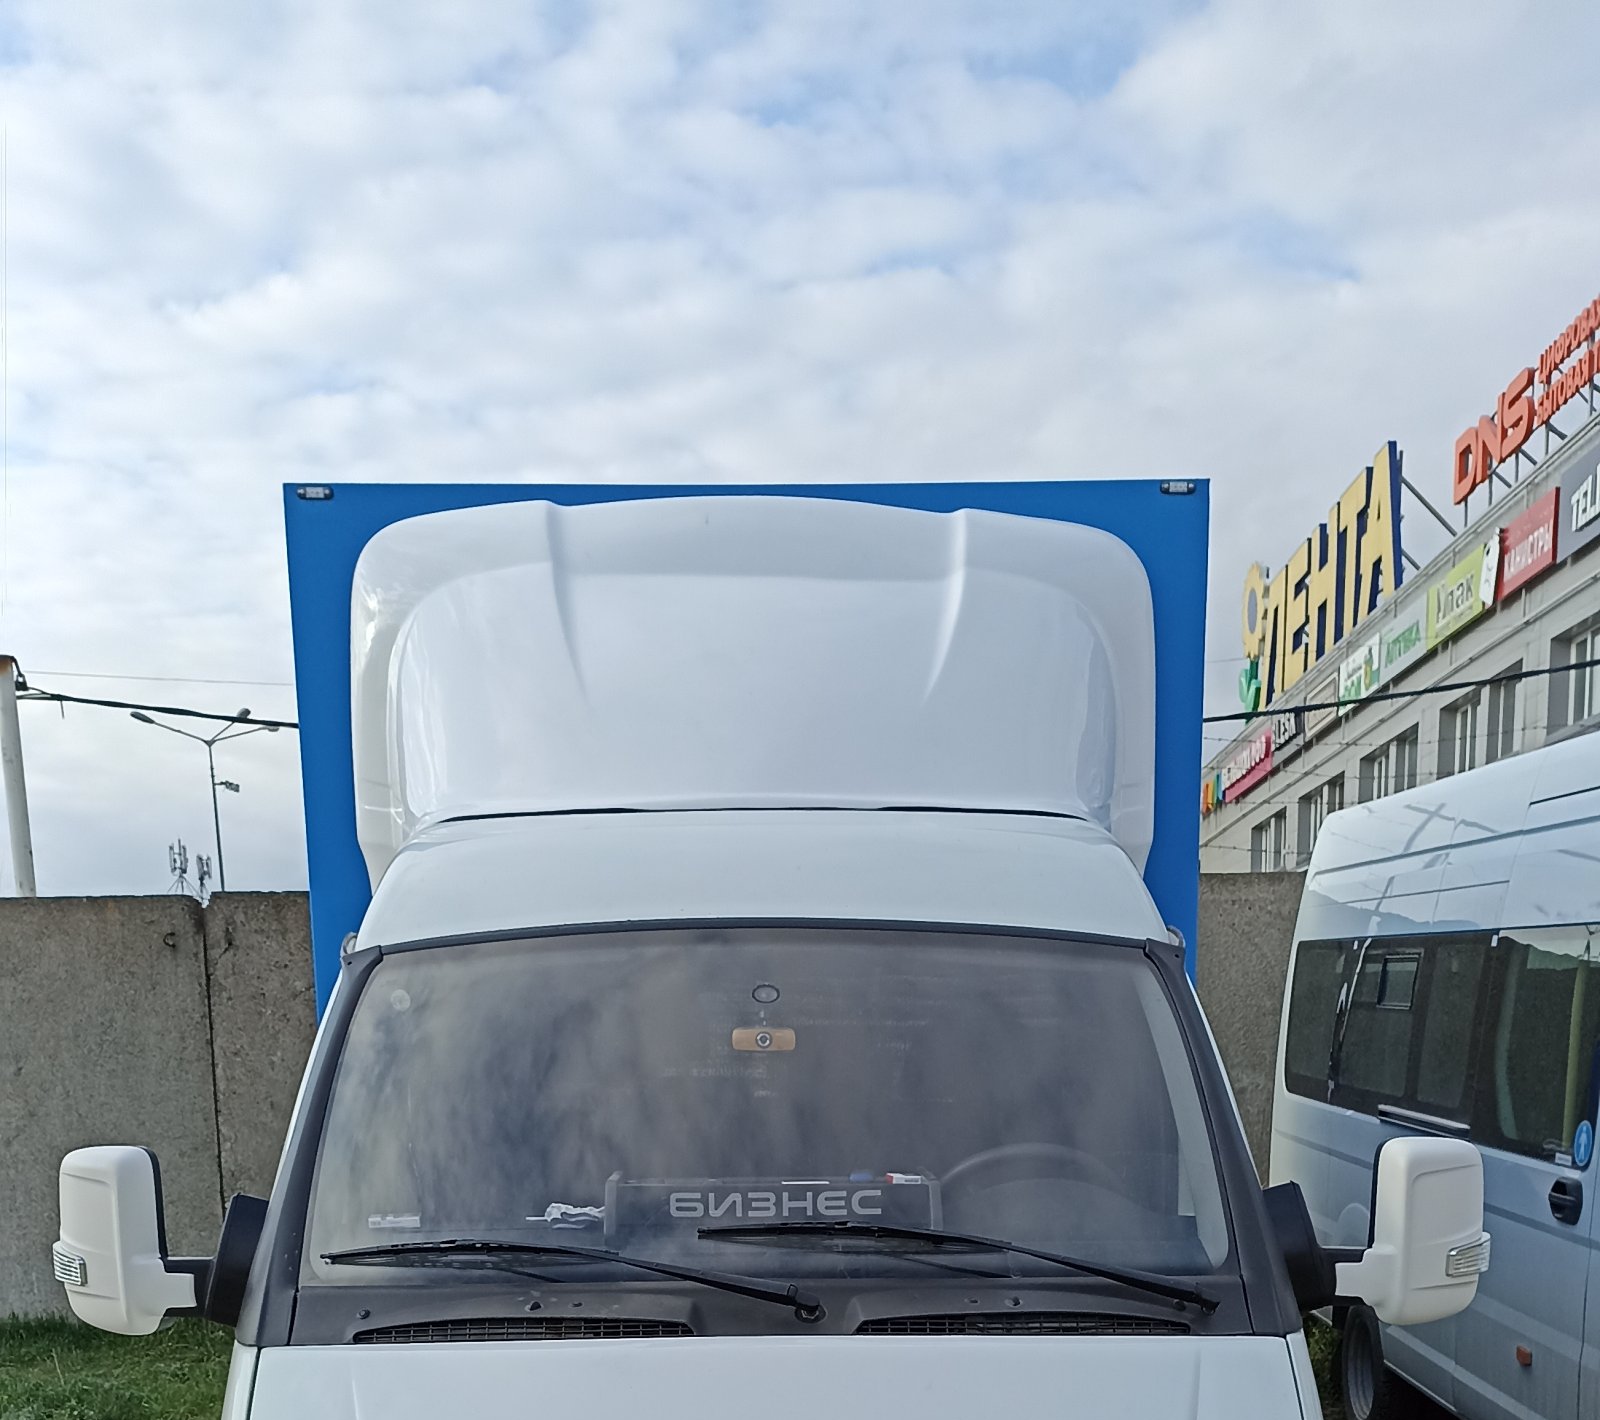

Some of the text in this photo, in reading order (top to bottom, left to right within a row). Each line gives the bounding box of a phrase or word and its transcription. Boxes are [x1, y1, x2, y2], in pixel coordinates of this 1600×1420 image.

[1453, 367, 1534, 504] DNS
[1536, 349, 1594, 425] БЫТОВАЯ
[1259, 441, 1402, 710] ЛЕНТА
[670, 1189, 882, 1217] БИЗНЕС
